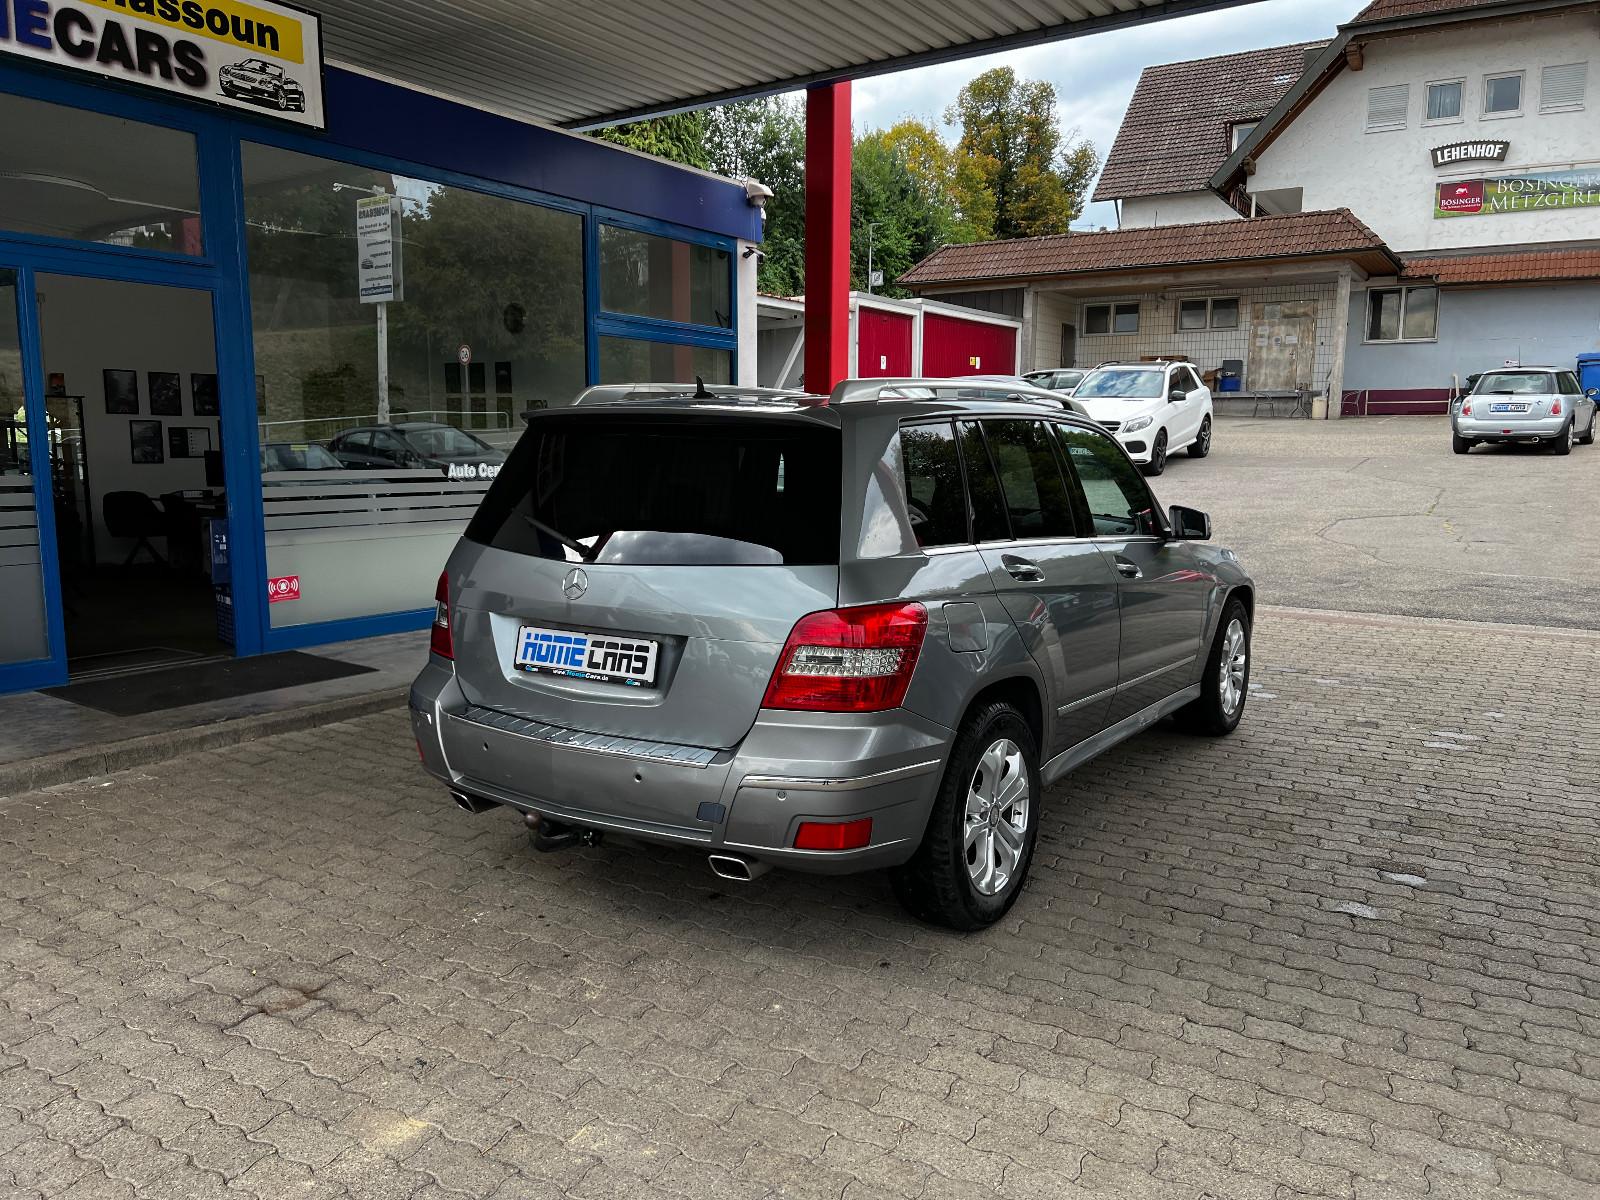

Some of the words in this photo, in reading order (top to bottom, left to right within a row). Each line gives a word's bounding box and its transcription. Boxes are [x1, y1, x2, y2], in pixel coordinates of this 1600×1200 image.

[102, 0, 280, 51] assoun
[1437, 144, 1503, 163] LEHENHOF
[448, 462, 476, 478] Auto
[478, 462, 504, 478] Cen
[522, 632, 587, 667] HOME
[587, 640, 650, 675] CARS
